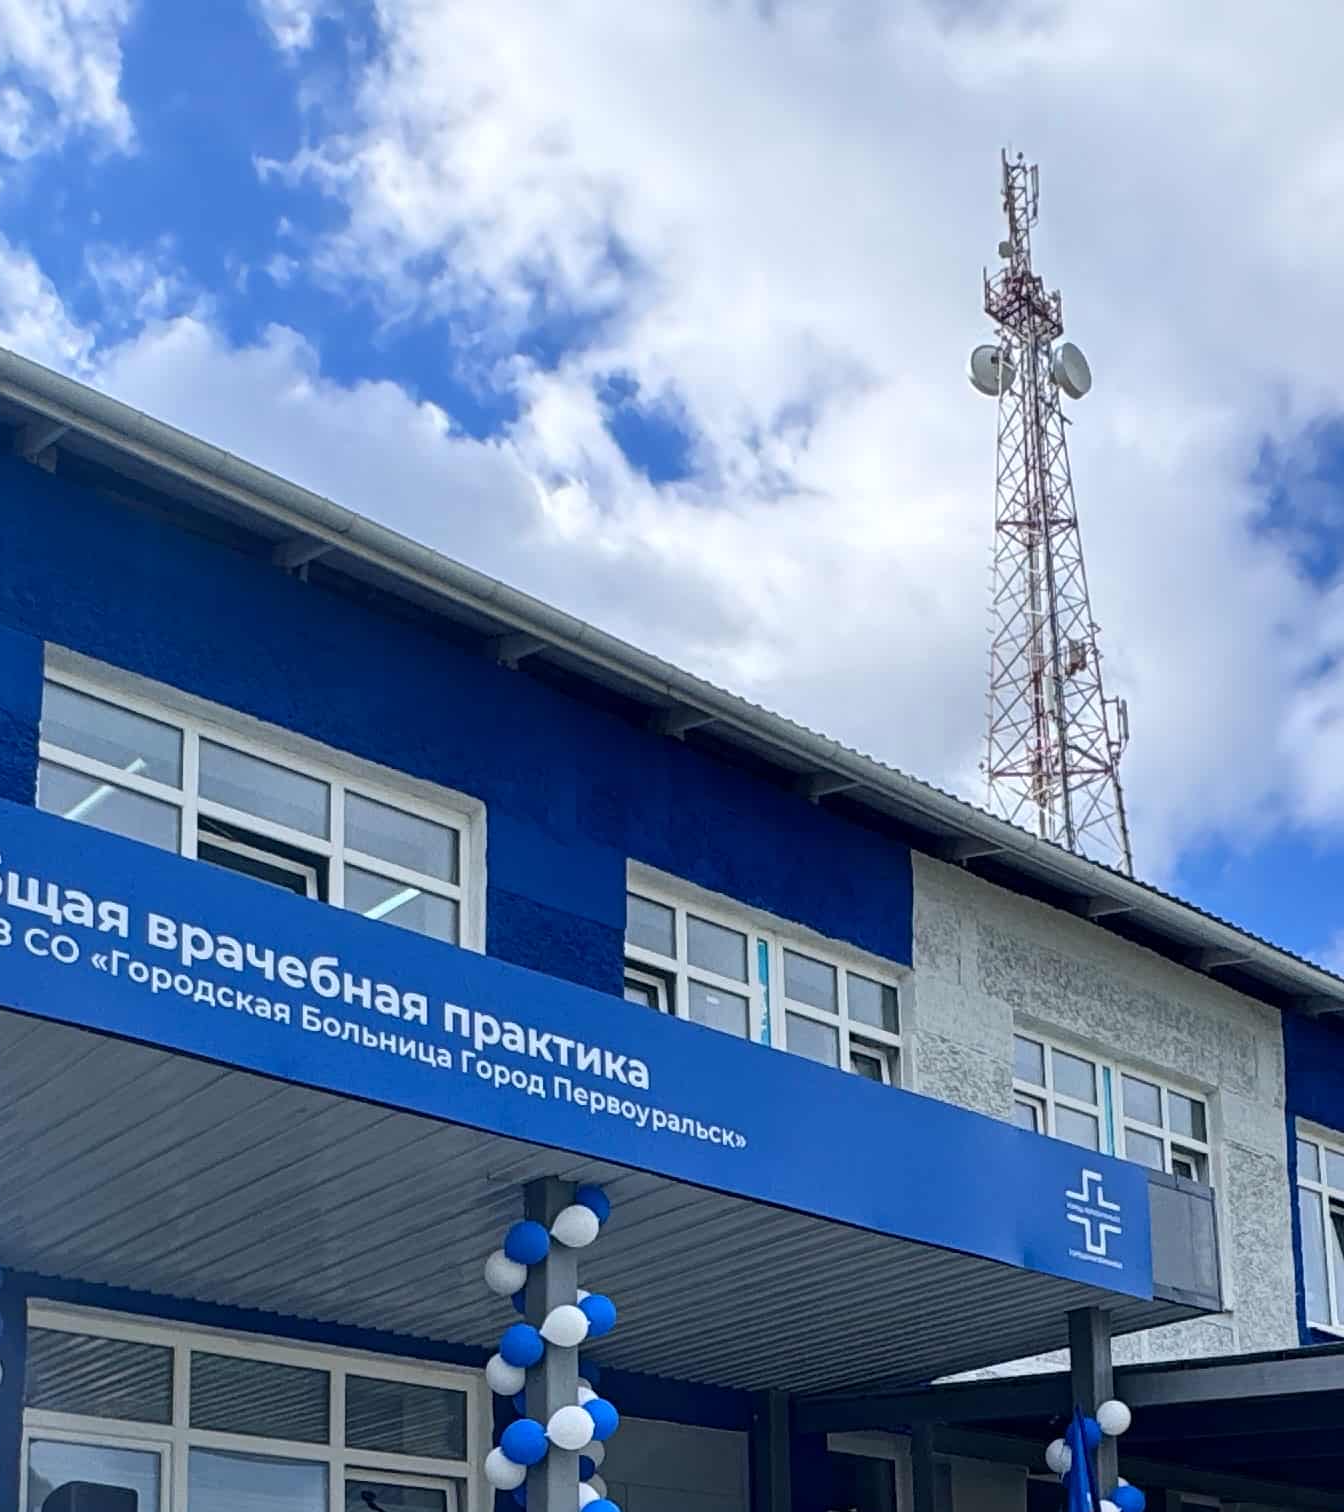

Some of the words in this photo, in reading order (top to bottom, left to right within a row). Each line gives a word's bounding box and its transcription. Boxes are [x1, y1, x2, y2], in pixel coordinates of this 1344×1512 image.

[23, 927, 80, 964] СО
[90, 949, 291, 1025] «Городская
[301, 1006, 453, 1069] Больница
[461, 1050, 546, 1099] Город
[554, 1075, 748, 1150] Первоуральск»
[147, 912, 428, 1025] врачебная
[444, 1000, 651, 1091] практика
